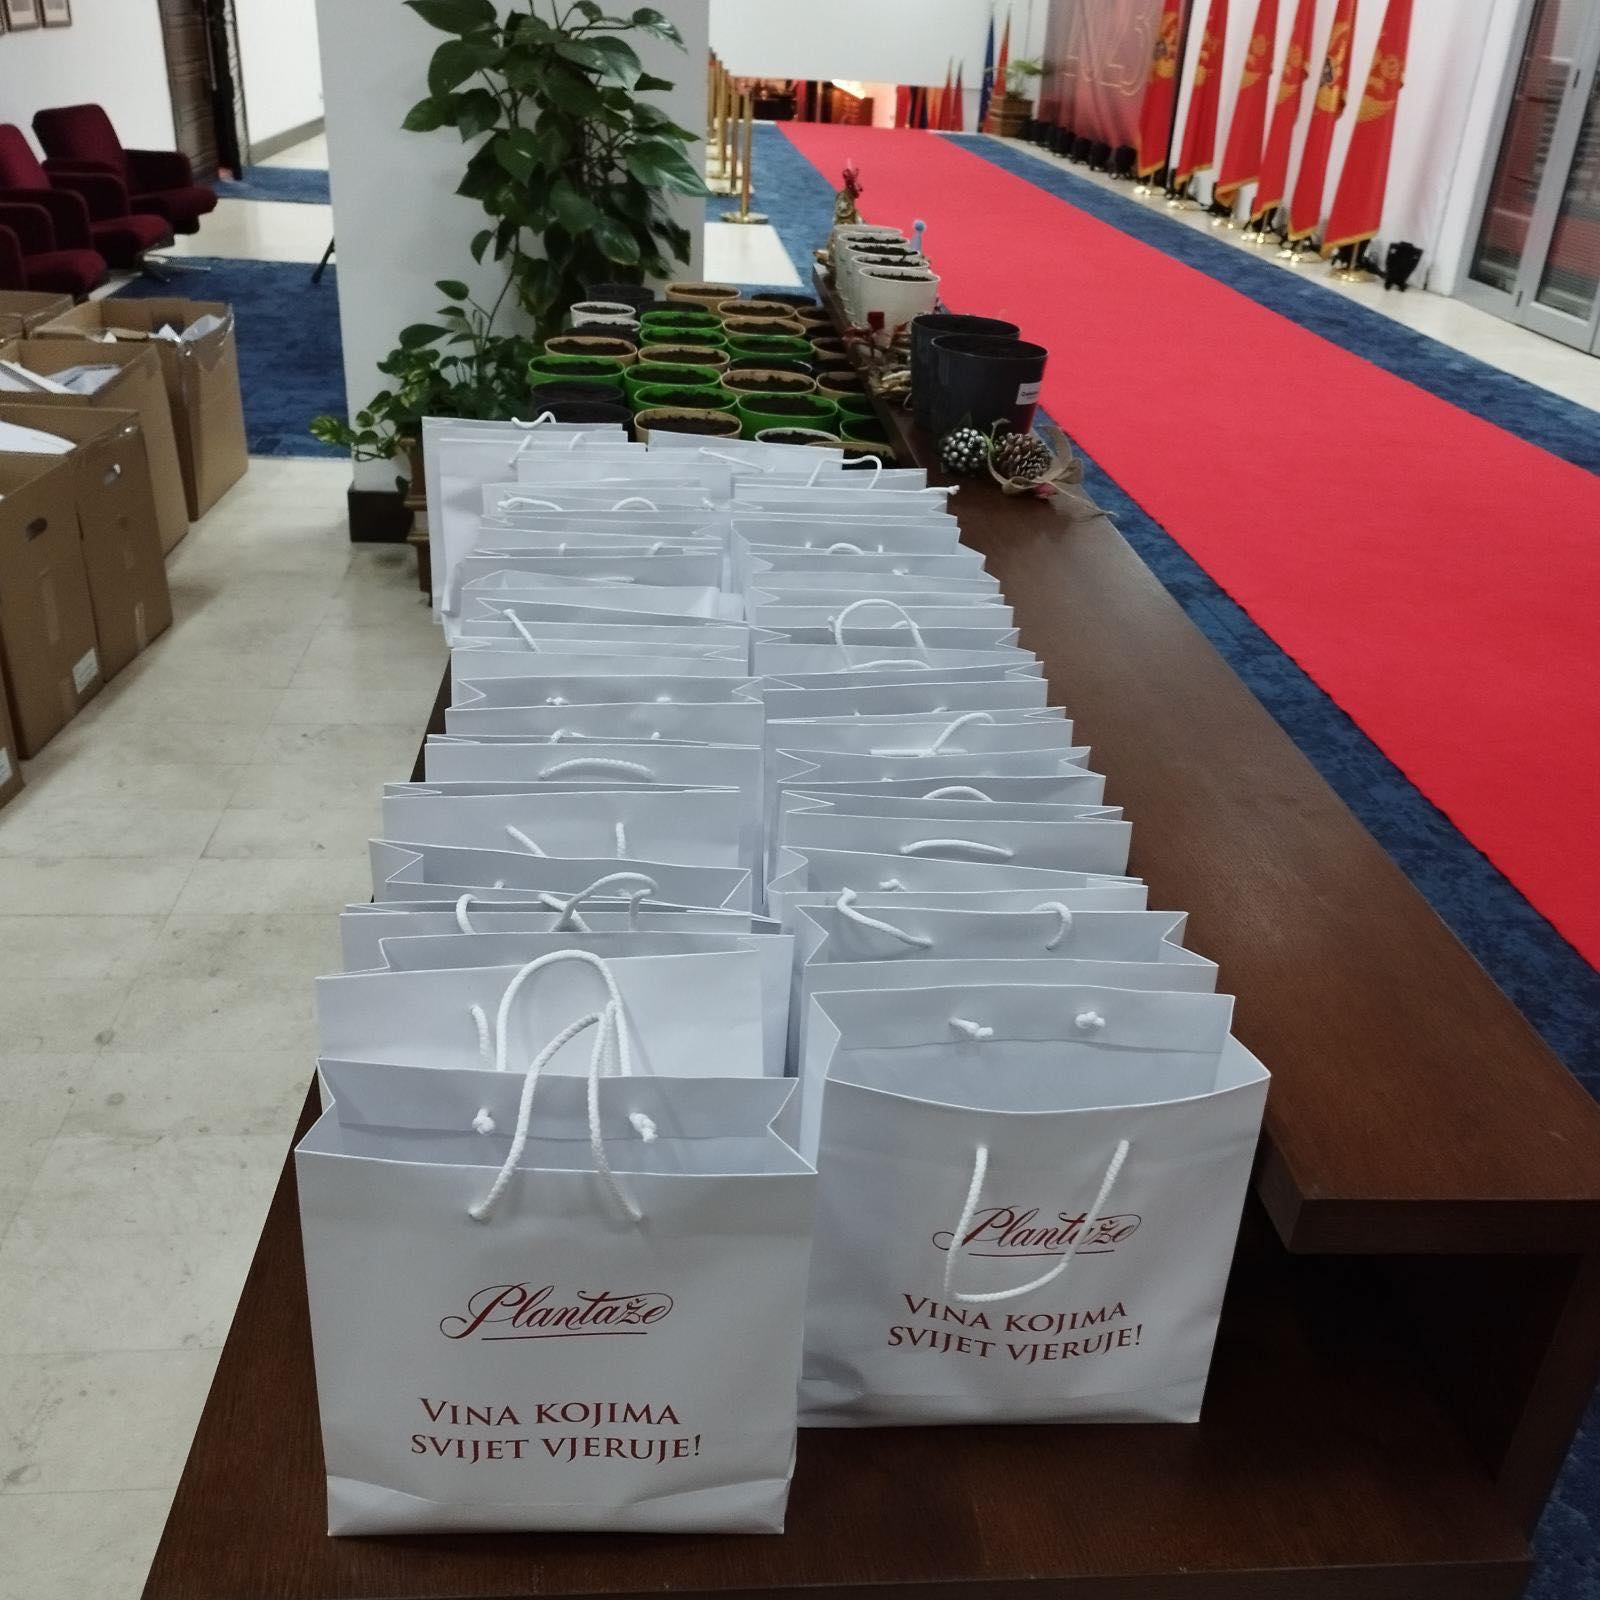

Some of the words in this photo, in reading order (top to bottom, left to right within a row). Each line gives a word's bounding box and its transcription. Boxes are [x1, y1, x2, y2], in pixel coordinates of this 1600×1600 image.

[440, 1282, 673, 1340] Plantaže
[903, 1293, 992, 1331] VINA
[1004, 1301, 1128, 1335] KOJIMA
[887, 1326, 996, 1358] SVIJET
[1006, 1324, 1143, 1365] VJERUJE!
[418, 1397, 520, 1426] VINA
[535, 1402, 680, 1428] KOJIMA
[411, 1433, 529, 1464] SVIJET
[540, 1433, 701, 1464] VJERUJE!
